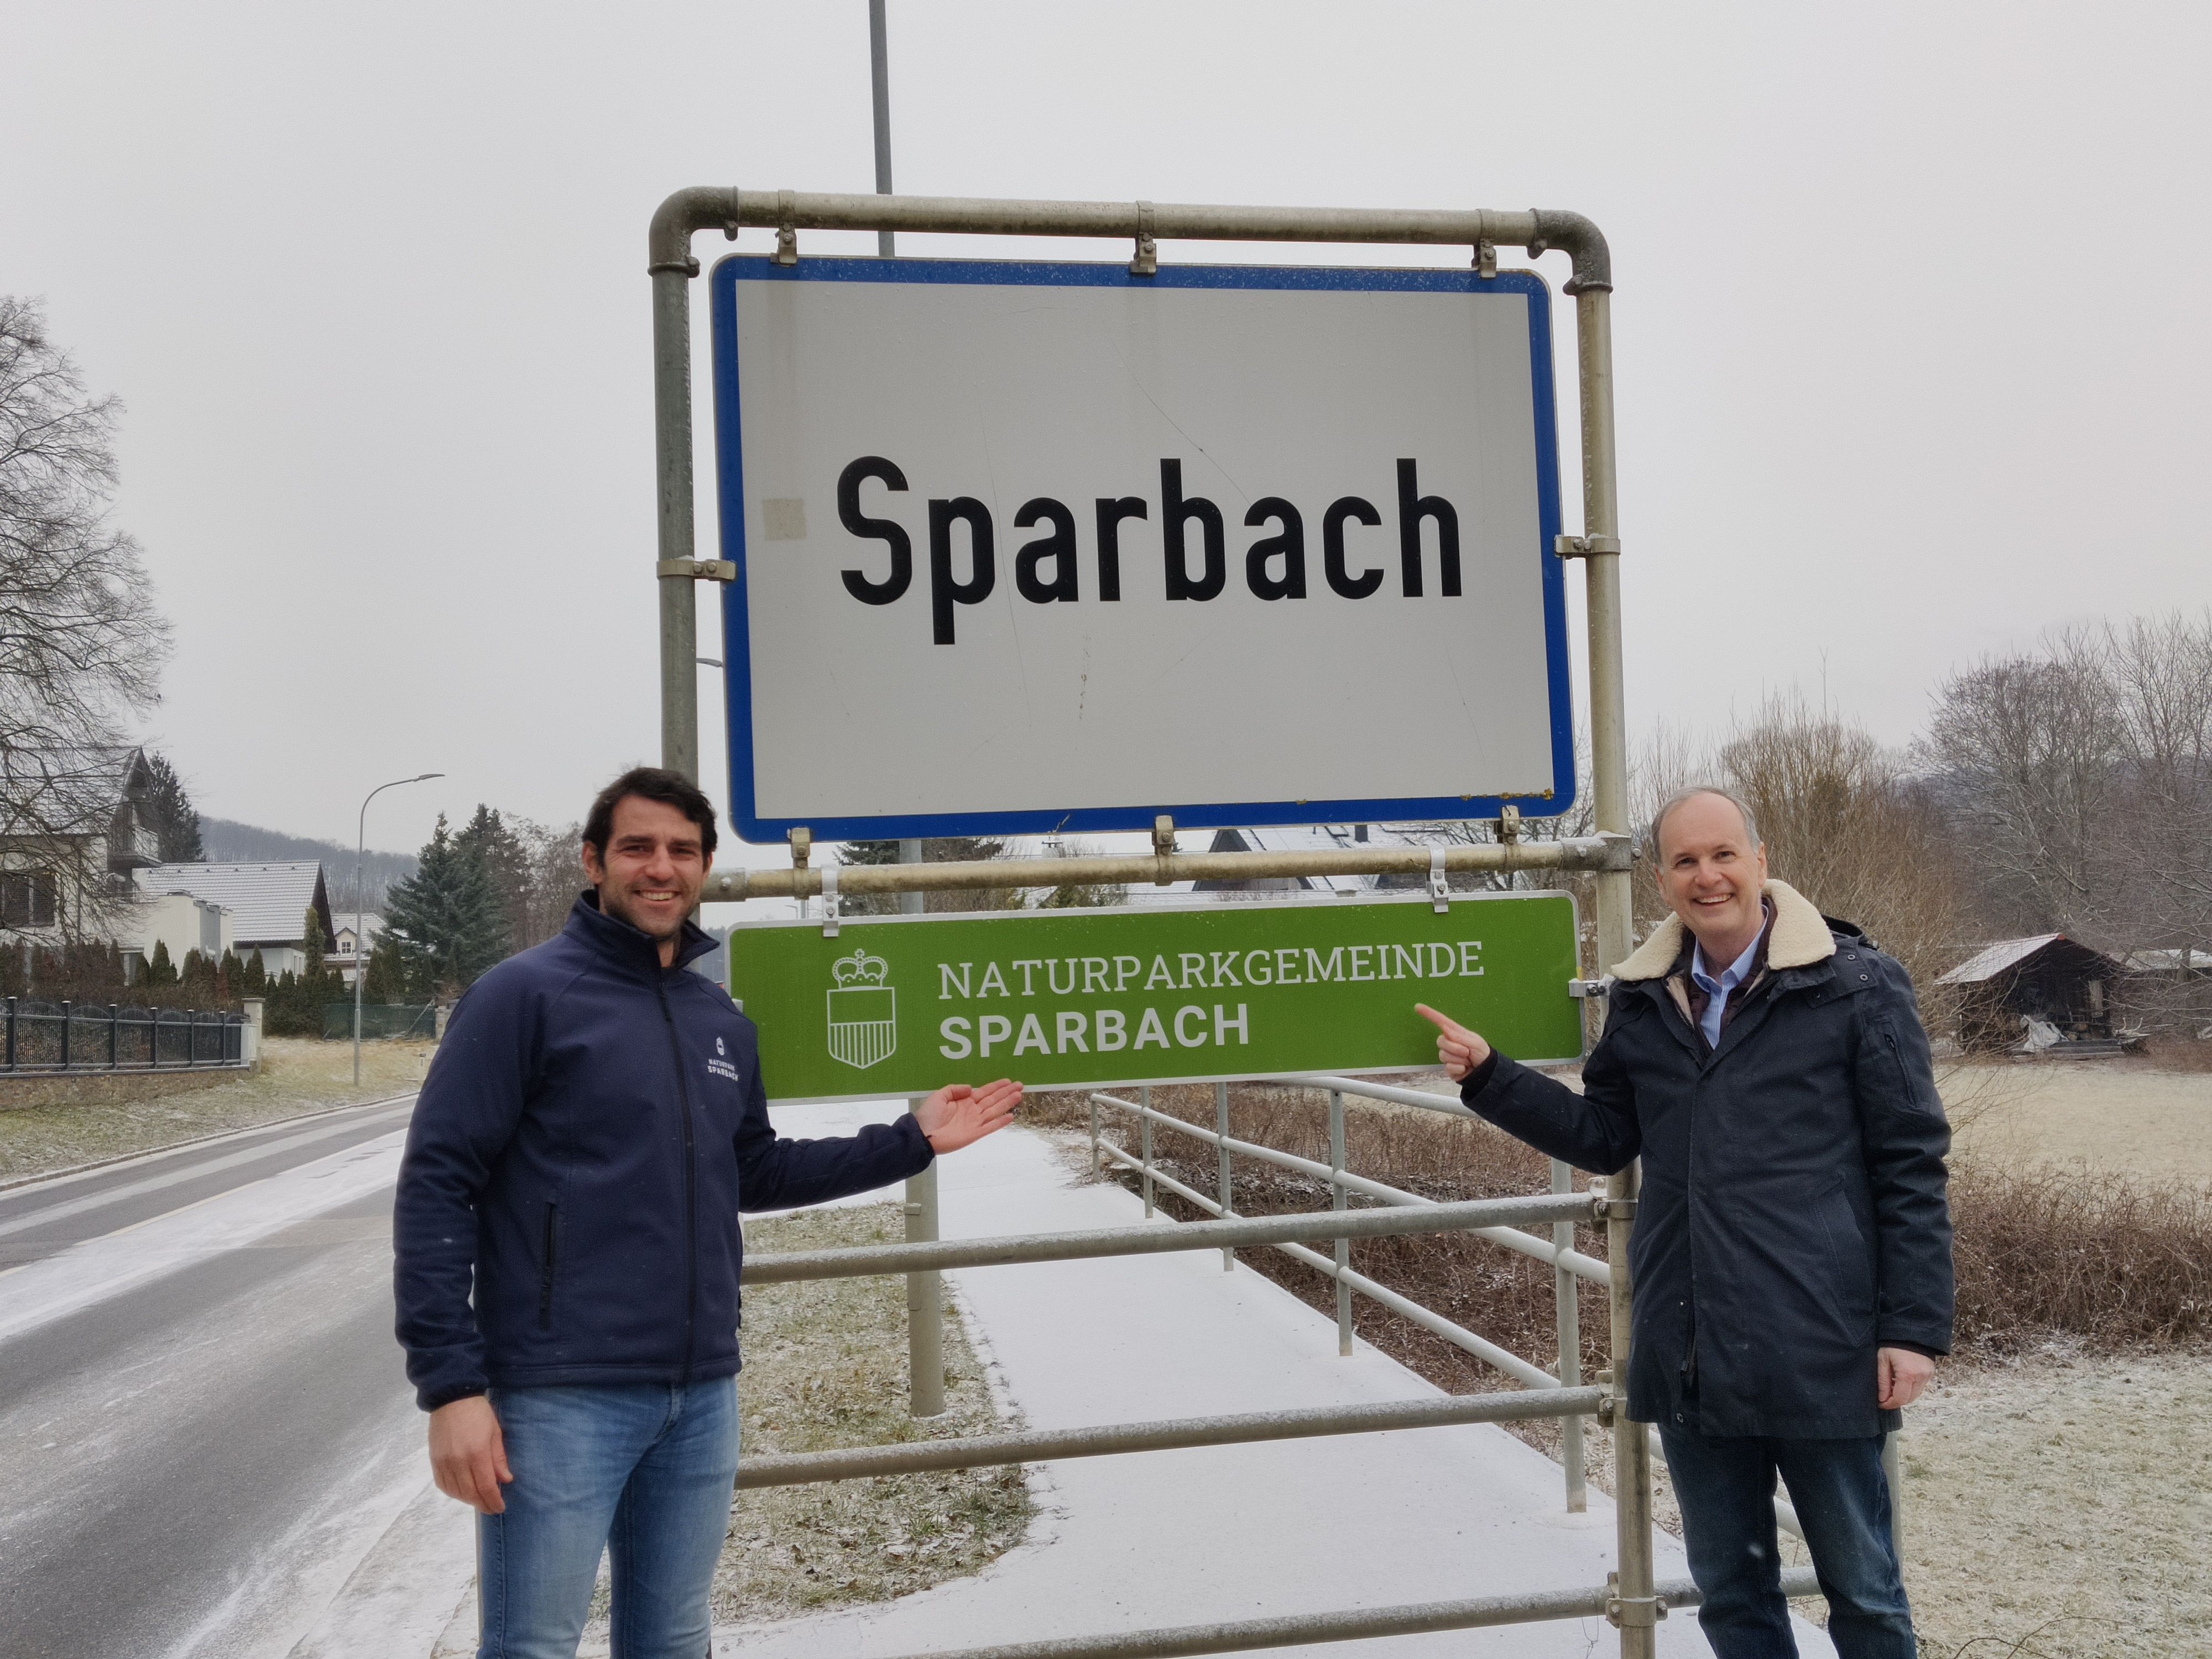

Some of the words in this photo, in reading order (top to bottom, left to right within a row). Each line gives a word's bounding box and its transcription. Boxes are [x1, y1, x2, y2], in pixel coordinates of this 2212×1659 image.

[837, 456, 1462, 645] Sparbach
[937, 941, 1484, 1000] NATURPARKGEMEINDE
[939, 1004, 1250, 1060] SPARBACH
[707, 1065, 738, 1081] SPARBACH
